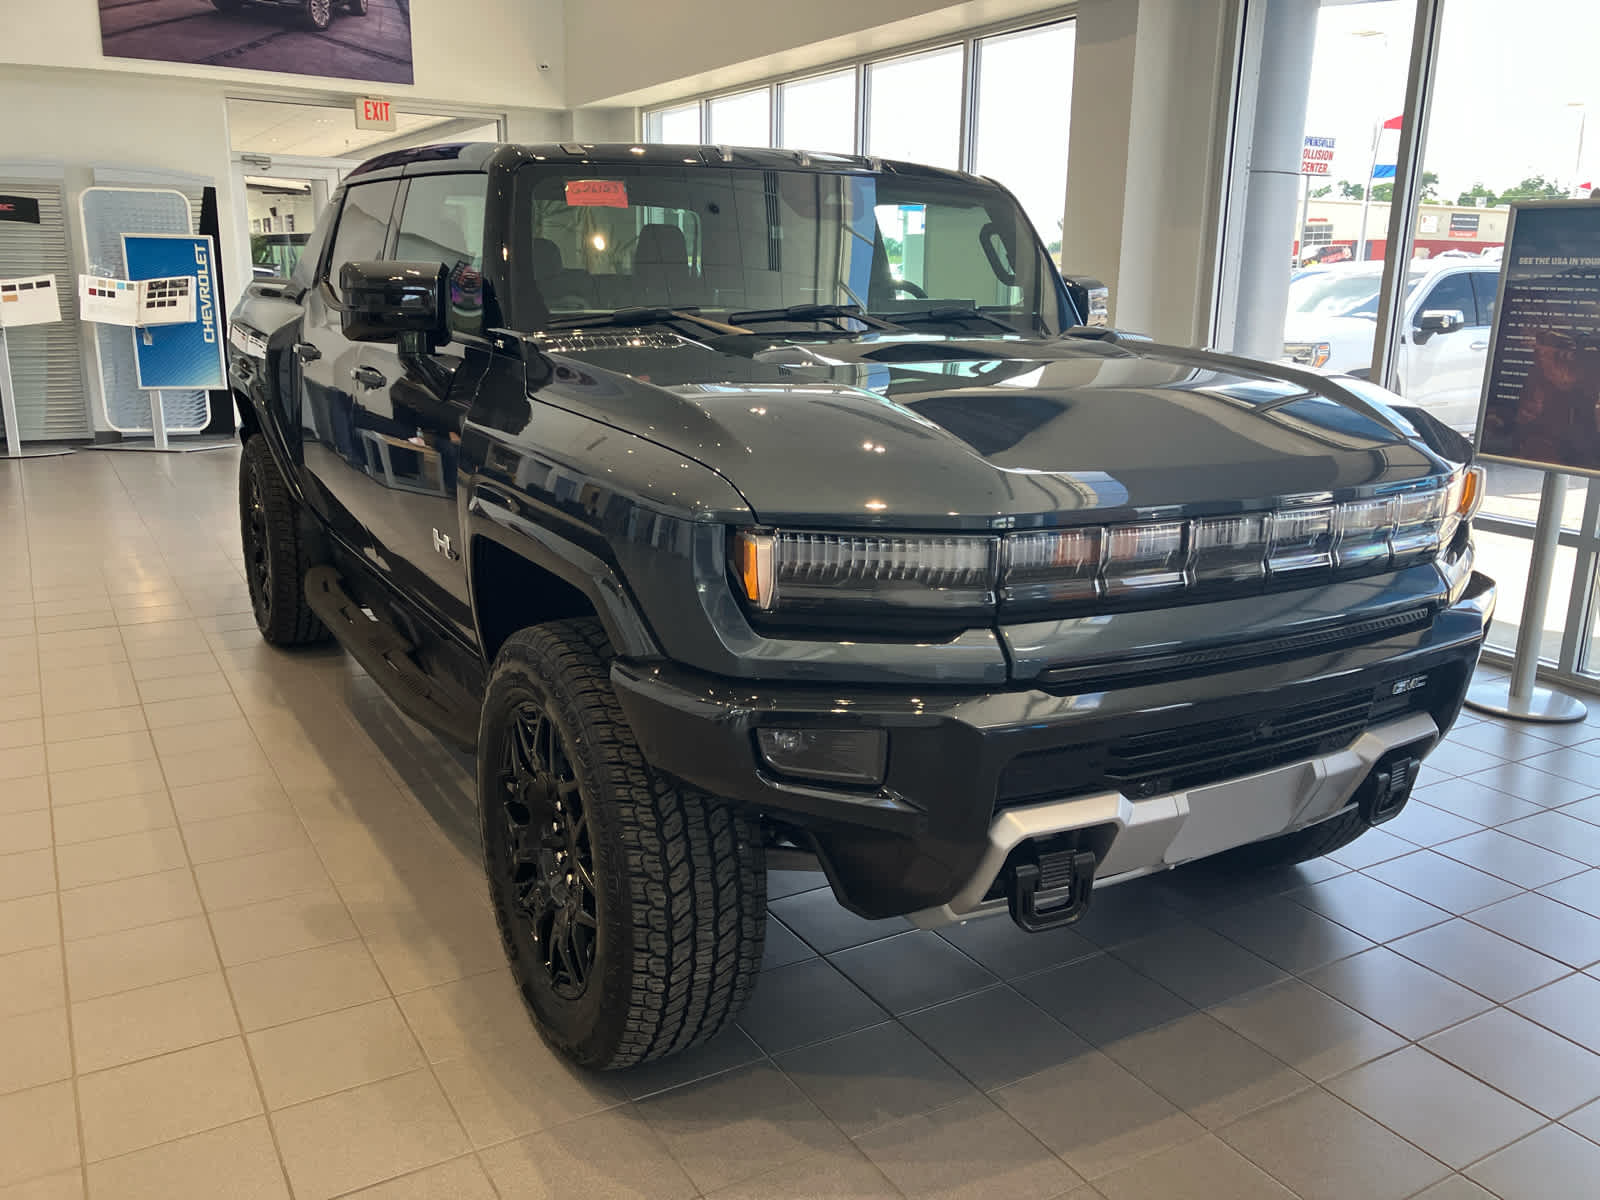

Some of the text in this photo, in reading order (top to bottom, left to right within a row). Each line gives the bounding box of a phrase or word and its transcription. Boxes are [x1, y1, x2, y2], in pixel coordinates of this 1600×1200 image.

[364, 101, 390, 121] EXIT
[1303, 148, 1334, 160] OLLISION
[1302, 161, 1329, 173] CENTER
[1519, 256, 1533, 265] SEE
[1535, 256, 1550, 265] THE
[1552, 256, 1568, 265] USA
[1569, 256, 1579, 265] IN
[194, 243, 215, 343] CHEVROLET
[1392, 674, 1429, 695] GMC
